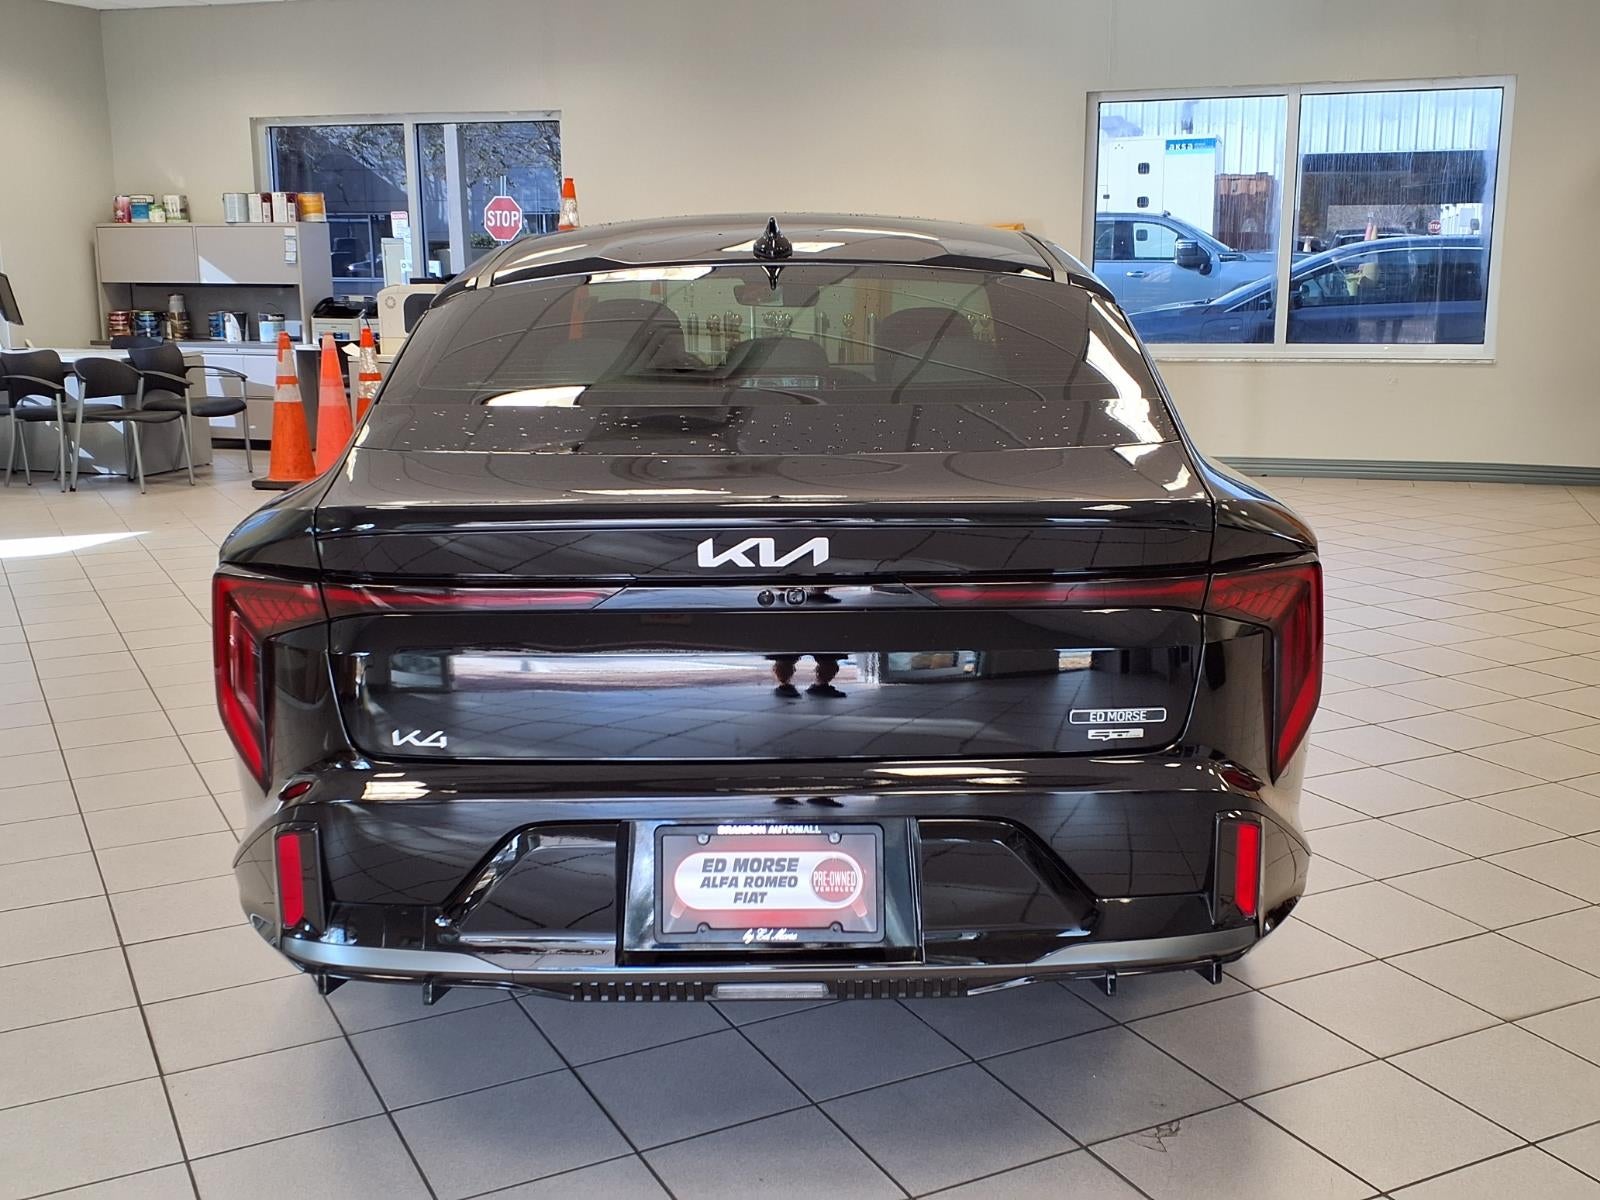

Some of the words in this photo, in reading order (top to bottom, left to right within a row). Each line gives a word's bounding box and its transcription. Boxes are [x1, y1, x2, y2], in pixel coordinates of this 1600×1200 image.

[487, 210, 519, 227] STOP
[697, 537, 829, 568] KIA
[1089, 712, 1105, 722] ED
[1107, 711, 1147, 721] MORSE
[392, 729, 448, 749] K4
[717, 825, 766, 835] BRANDON
[768, 824, 821, 834] AUTOMALL
[702, 858, 727, 873] ED
[733, 857, 799, 873] MORSE
[700, 876, 739, 888] ALFA
[744, 876, 798, 888] ROMEO
[813, 871, 856, 887] PRE-OWNED
[733, 892, 768, 903] FIAT
